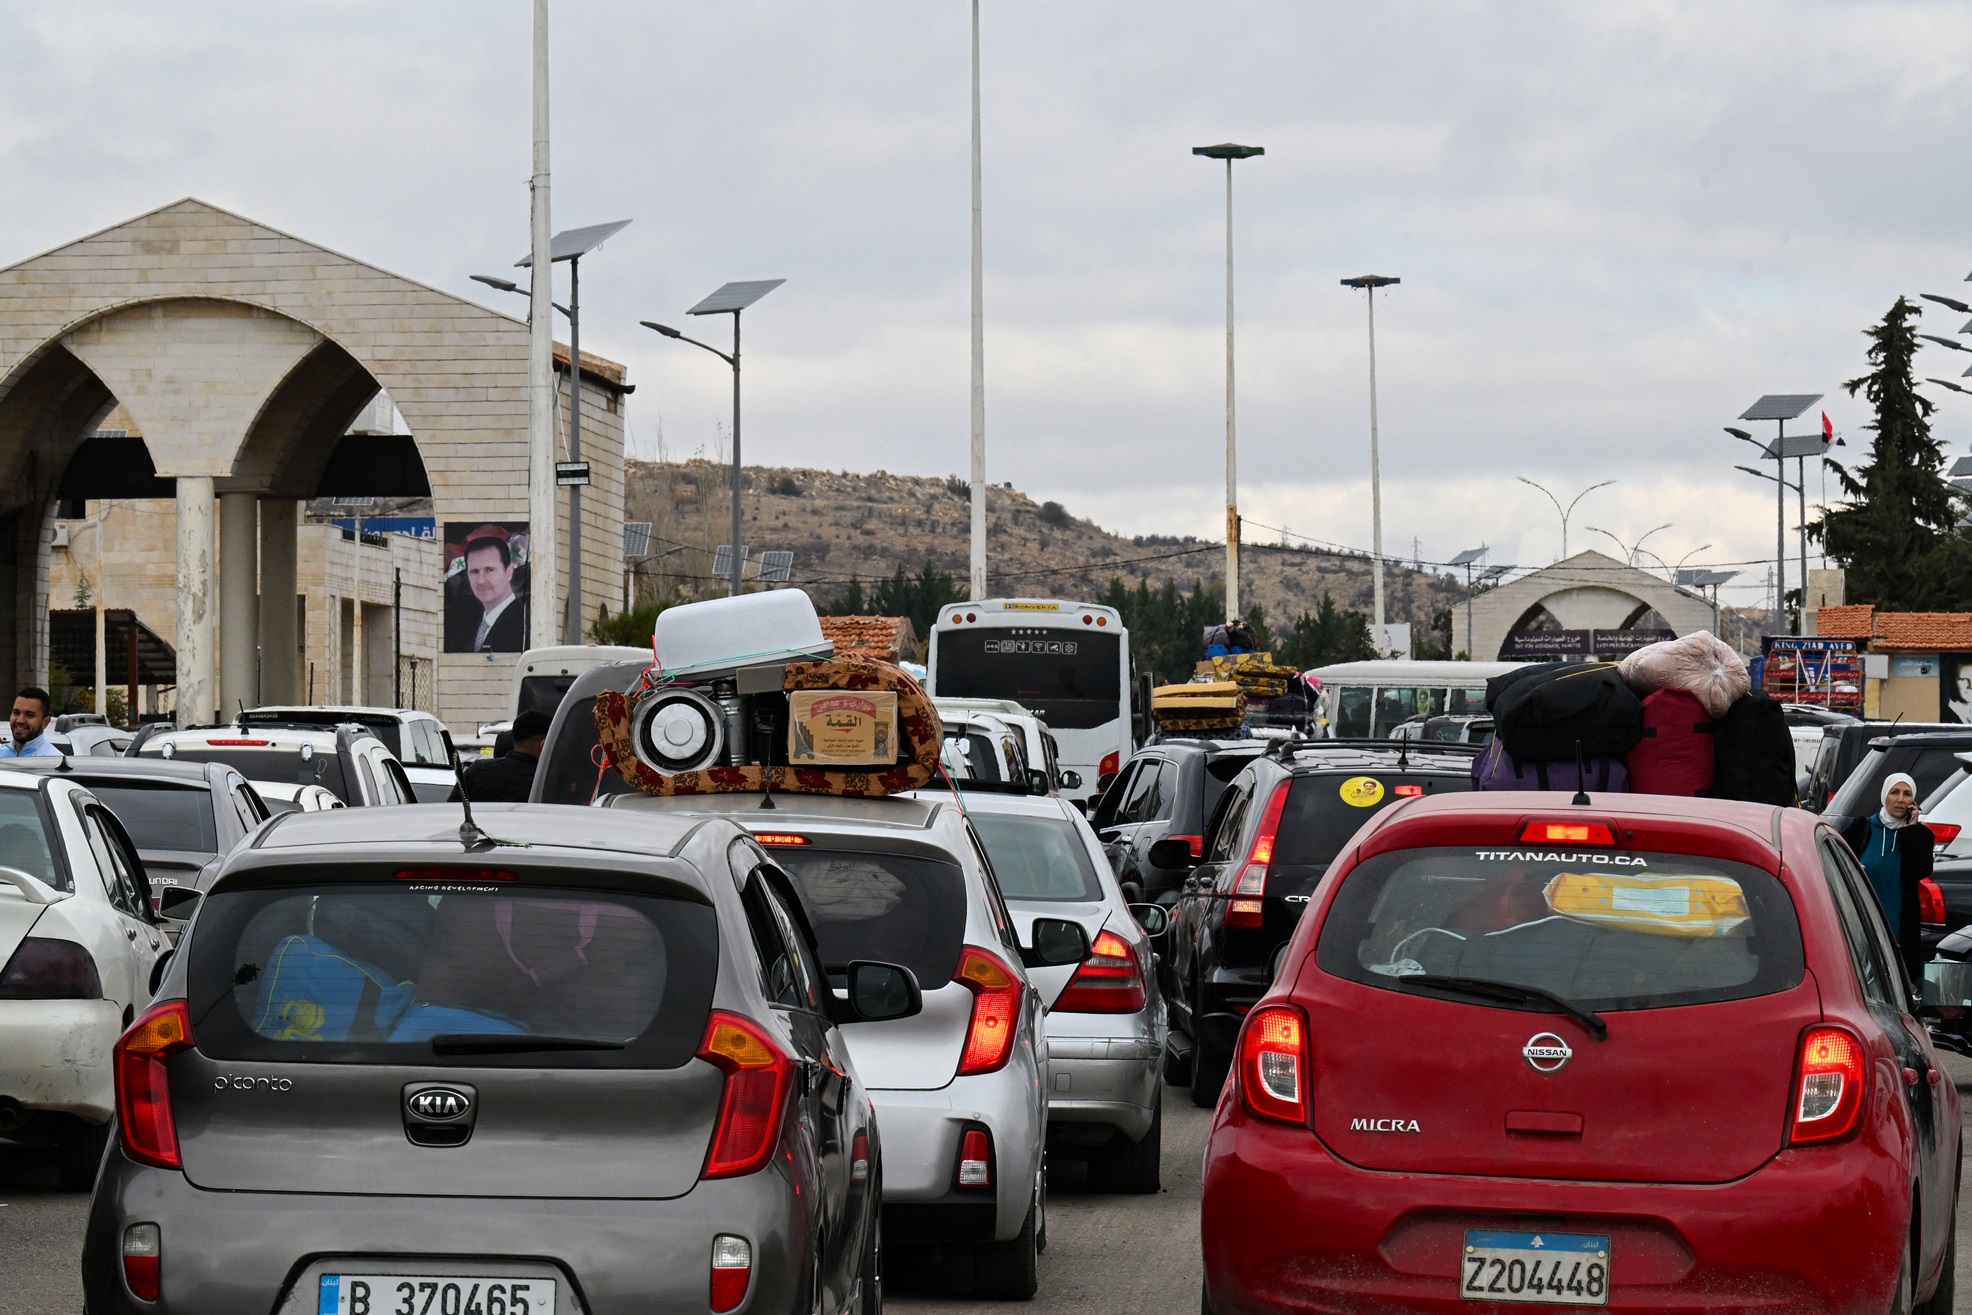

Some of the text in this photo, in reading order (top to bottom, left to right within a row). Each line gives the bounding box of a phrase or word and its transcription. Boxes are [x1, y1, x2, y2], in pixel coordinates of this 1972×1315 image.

[1774, 642, 1797, 650] KING
[1802, 642, 1824, 650] ZIAD
[1475, 851, 1648, 867] TITANAUTO.CA
[149, 877, 177, 886] UNDAI
[1284, 895, 1311, 903] CR
[1527, 1048, 1567, 1057] NISSAN
[214, 1073, 292, 1094] picanto
[419, 1096, 459, 1113] KIA
[1350, 1118, 1421, 1133] MICRA
[1582, 1241, 1599, 1249] لبنان
[321, 1278, 339, 1287] لبنان
[1466, 1257, 1605, 1297] Z204448
[350, 1280, 531, 1315] B 370465
